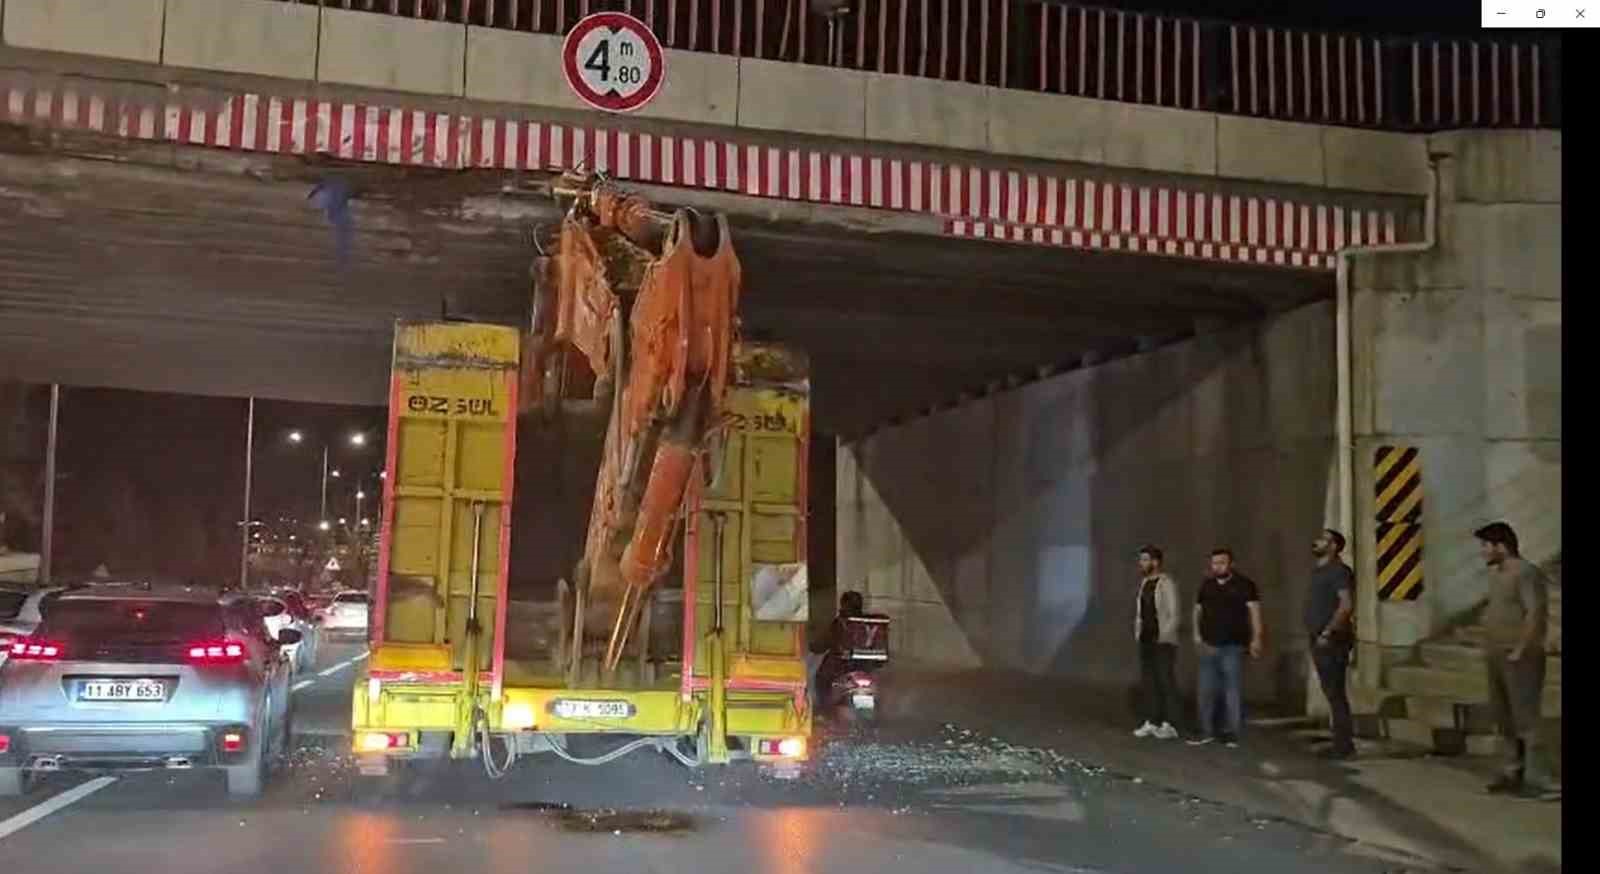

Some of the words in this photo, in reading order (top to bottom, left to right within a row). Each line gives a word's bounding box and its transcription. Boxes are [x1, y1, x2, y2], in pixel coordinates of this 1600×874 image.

[619, 42, 634, 56] m
[584, 39, 611, 82] 4
[87, 685, 102, 697] 11
[137, 686, 162, 698] 653
